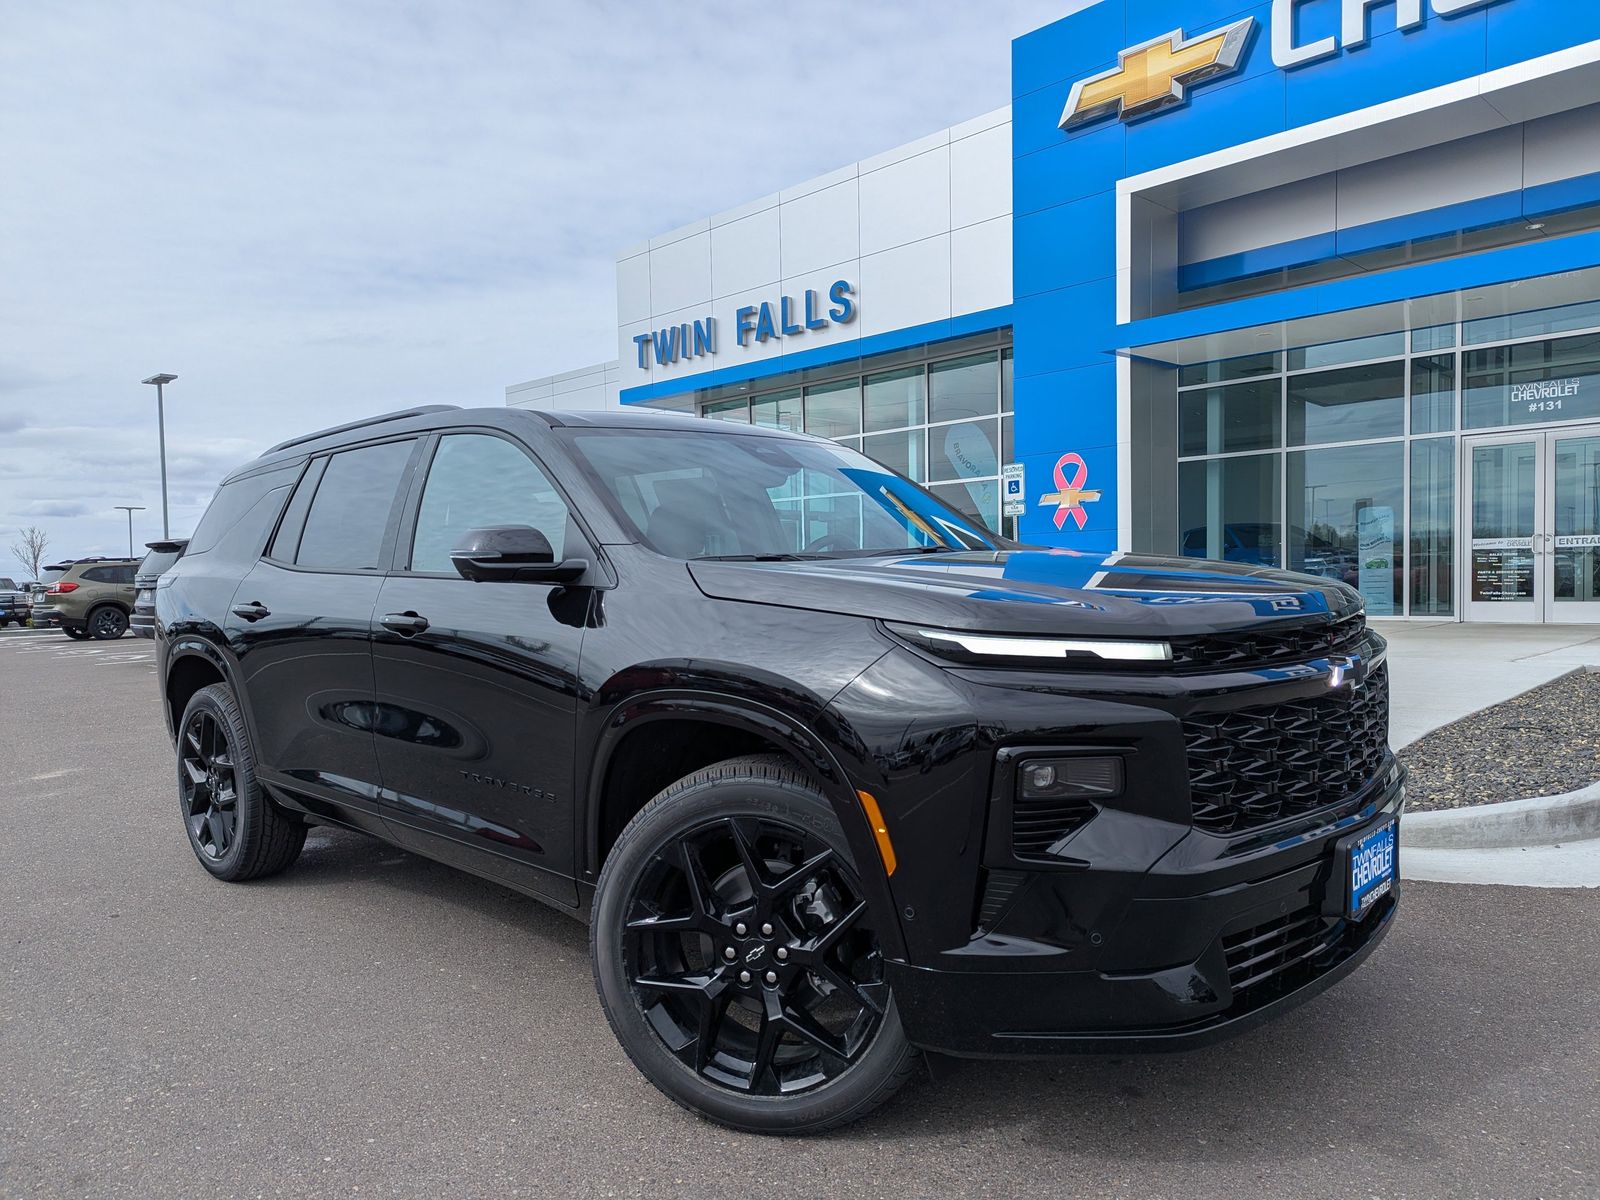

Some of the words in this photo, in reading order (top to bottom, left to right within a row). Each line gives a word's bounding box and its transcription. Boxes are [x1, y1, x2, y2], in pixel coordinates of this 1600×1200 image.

[1271, 0, 1500, 68] CH
[633, 316, 716, 369] TWIN
[736, 280, 855, 347] FALLS
[1511, 384, 1579, 401] CHEVROLET
[1528, 400, 1562, 412] #131
[952, 442, 989, 491] BRAVORAA
[1559, 537, 1600, 545] ENTRA
[459, 770, 556, 803] TRAVERSE
[1353, 834, 1393, 868] TWINFALLS
[1352, 846, 1393, 891] CHEVROLET
